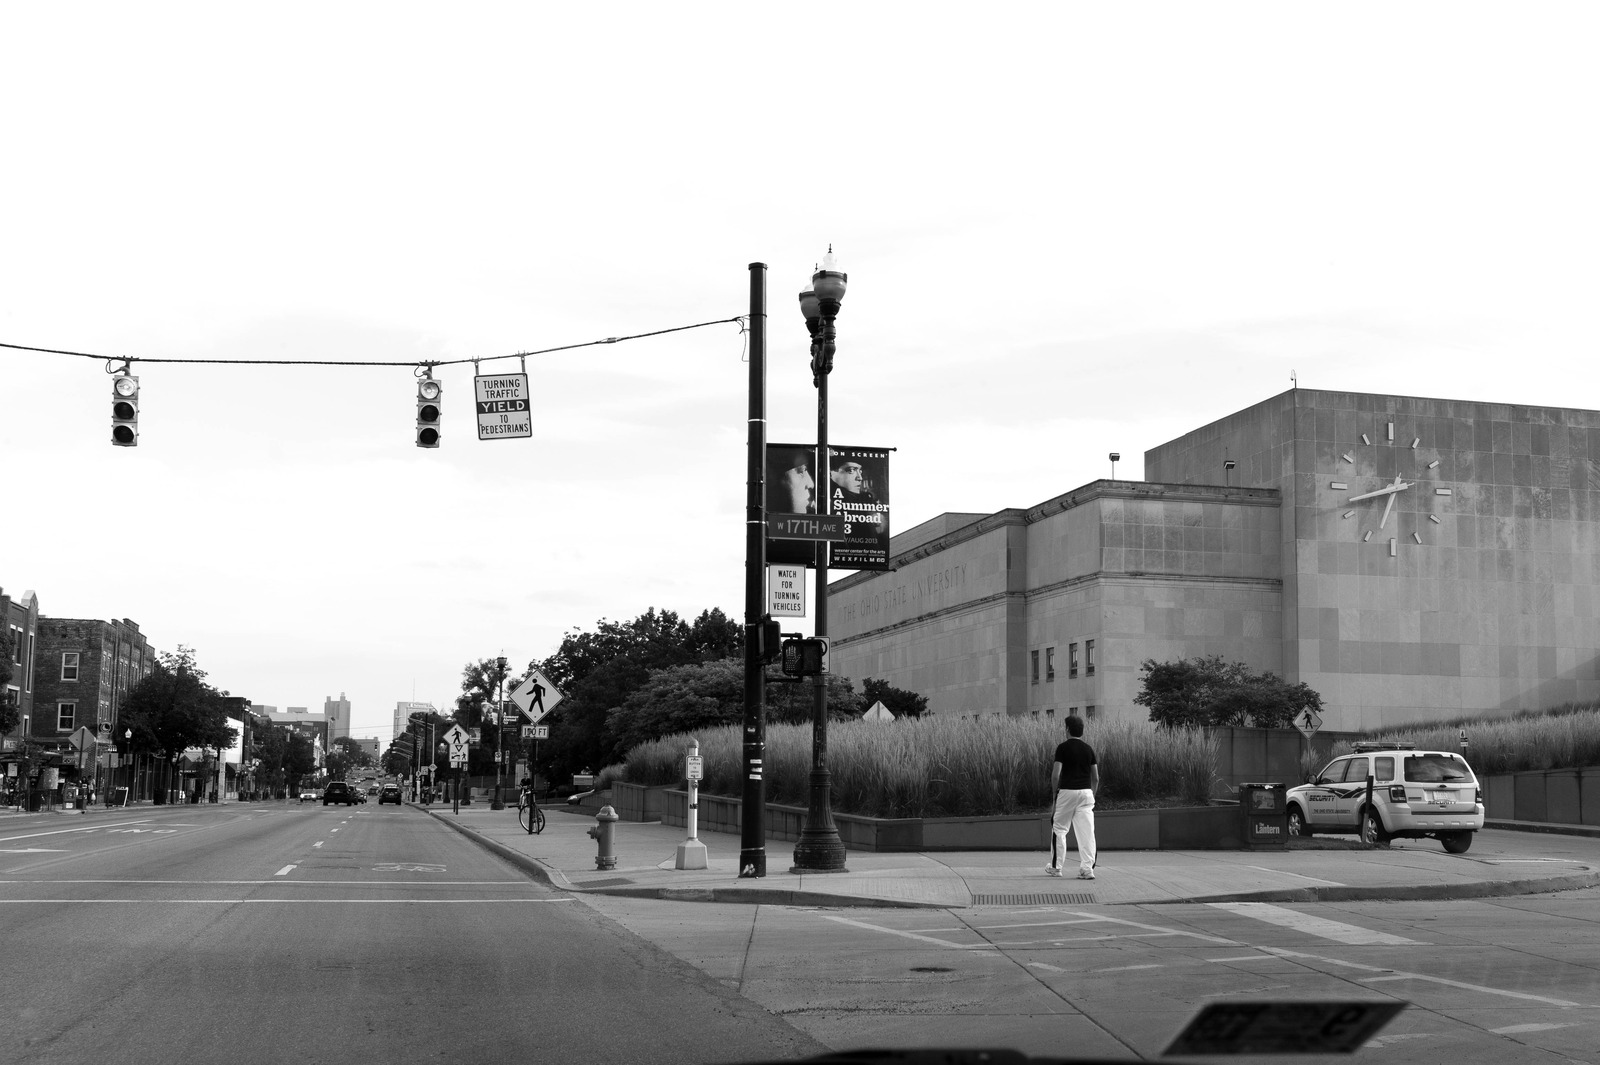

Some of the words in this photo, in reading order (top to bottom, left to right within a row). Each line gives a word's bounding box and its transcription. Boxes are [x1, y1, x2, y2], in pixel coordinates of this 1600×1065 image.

[483, 379, 520, 389] TURNING
[485, 389, 519, 399] TRAFFIC
[482, 401, 525, 412] YIELD
[500, 414, 508, 423] TO
[481, 423, 528, 434] PEDESTRIANS
[833, 488, 844, 498] A
[833, 500, 889, 512] Summer
[777, 521, 784, 530] W
[787, 520, 819, 534] 17TH
[821, 523, 836, 533] AVE
[777, 570, 797, 578] WATCH
[781, 580, 793, 589] FOR
[774, 592, 800, 600] TURNING
[843, 604, 856, 623] THE
[860, 595, 880, 617] OHIO
[884, 585, 907, 609] STATE
[912, 563, 968, 600] UNIVERSITY
[773, 603, 801, 611] VEHICLES
[538, 728, 547, 736] FT
[1255, 824, 1280, 834] Lantern
